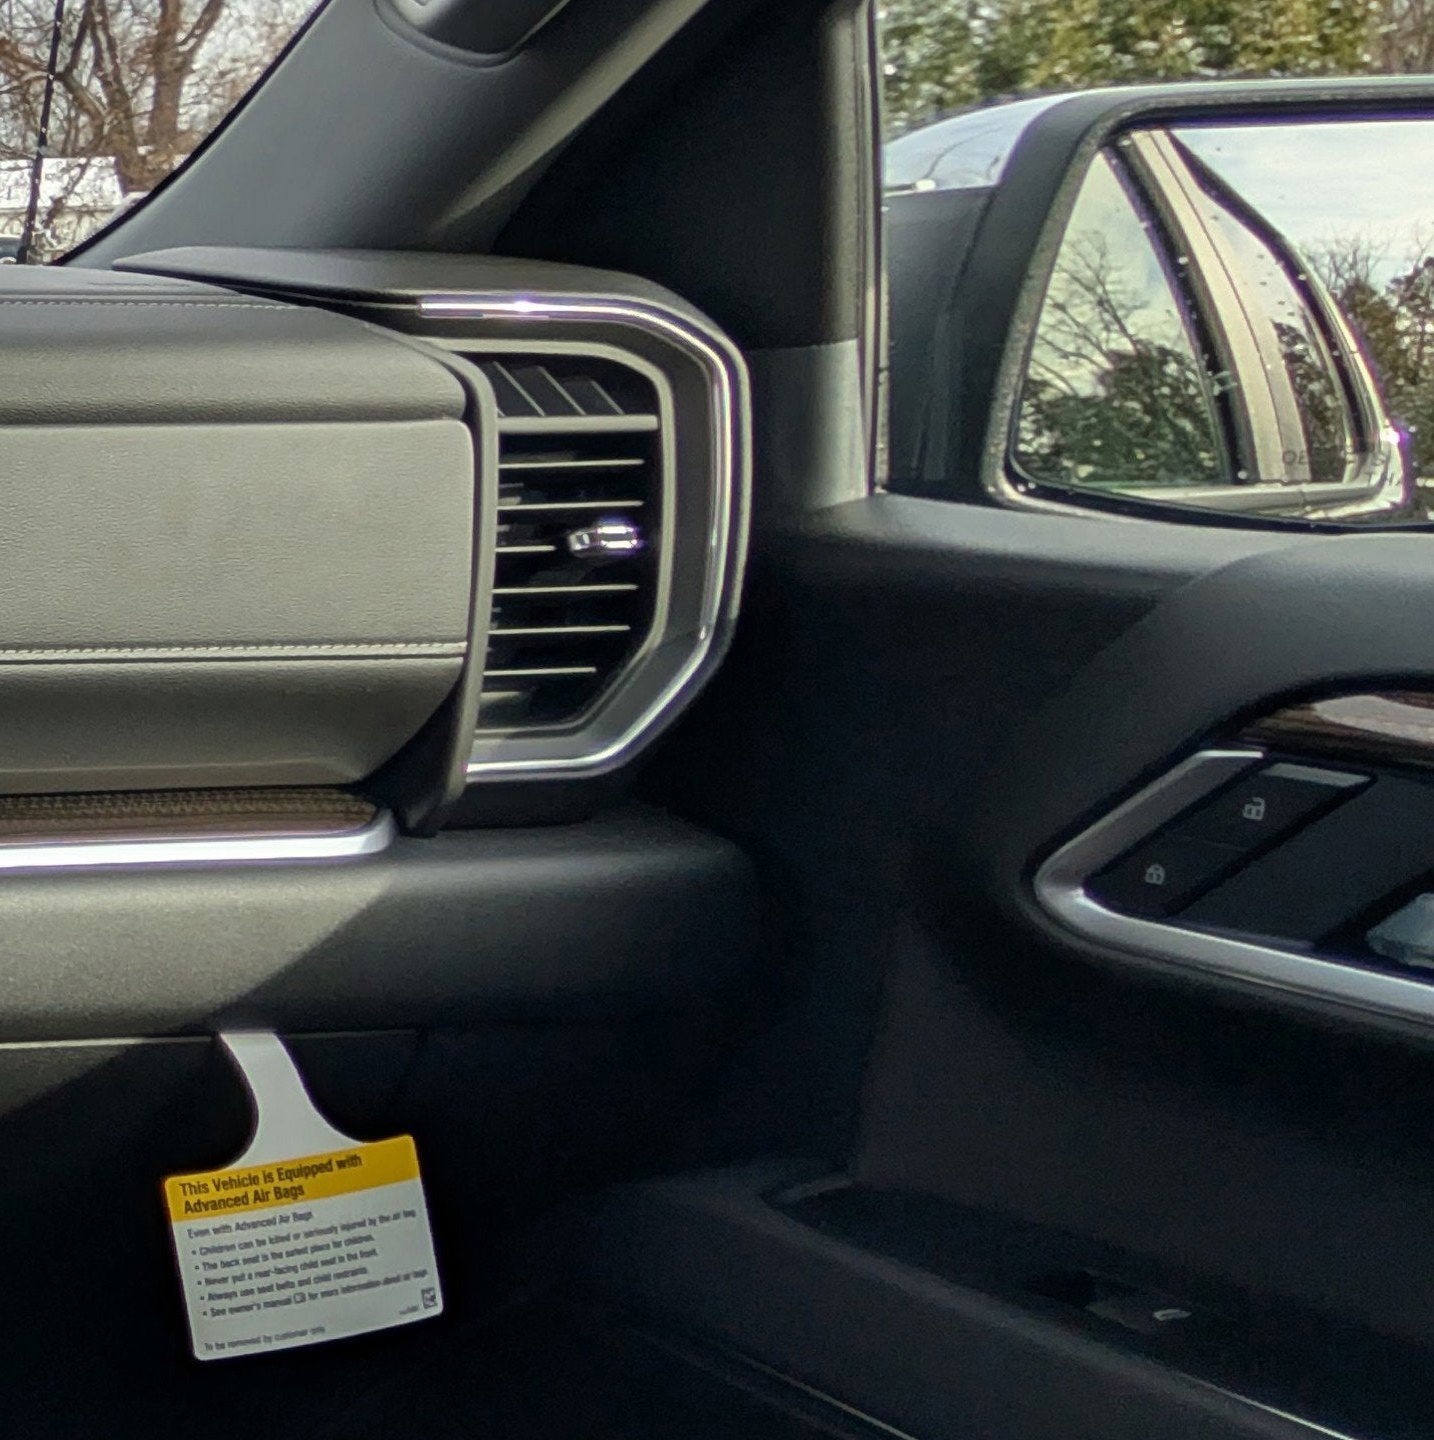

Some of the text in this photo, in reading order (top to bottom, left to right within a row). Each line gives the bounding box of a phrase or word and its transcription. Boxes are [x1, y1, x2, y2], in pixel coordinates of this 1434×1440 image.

[179, 1154, 363, 1197] This Vehicle is Equipped with
[184, 1184, 305, 1215] Advanced Air Bags
